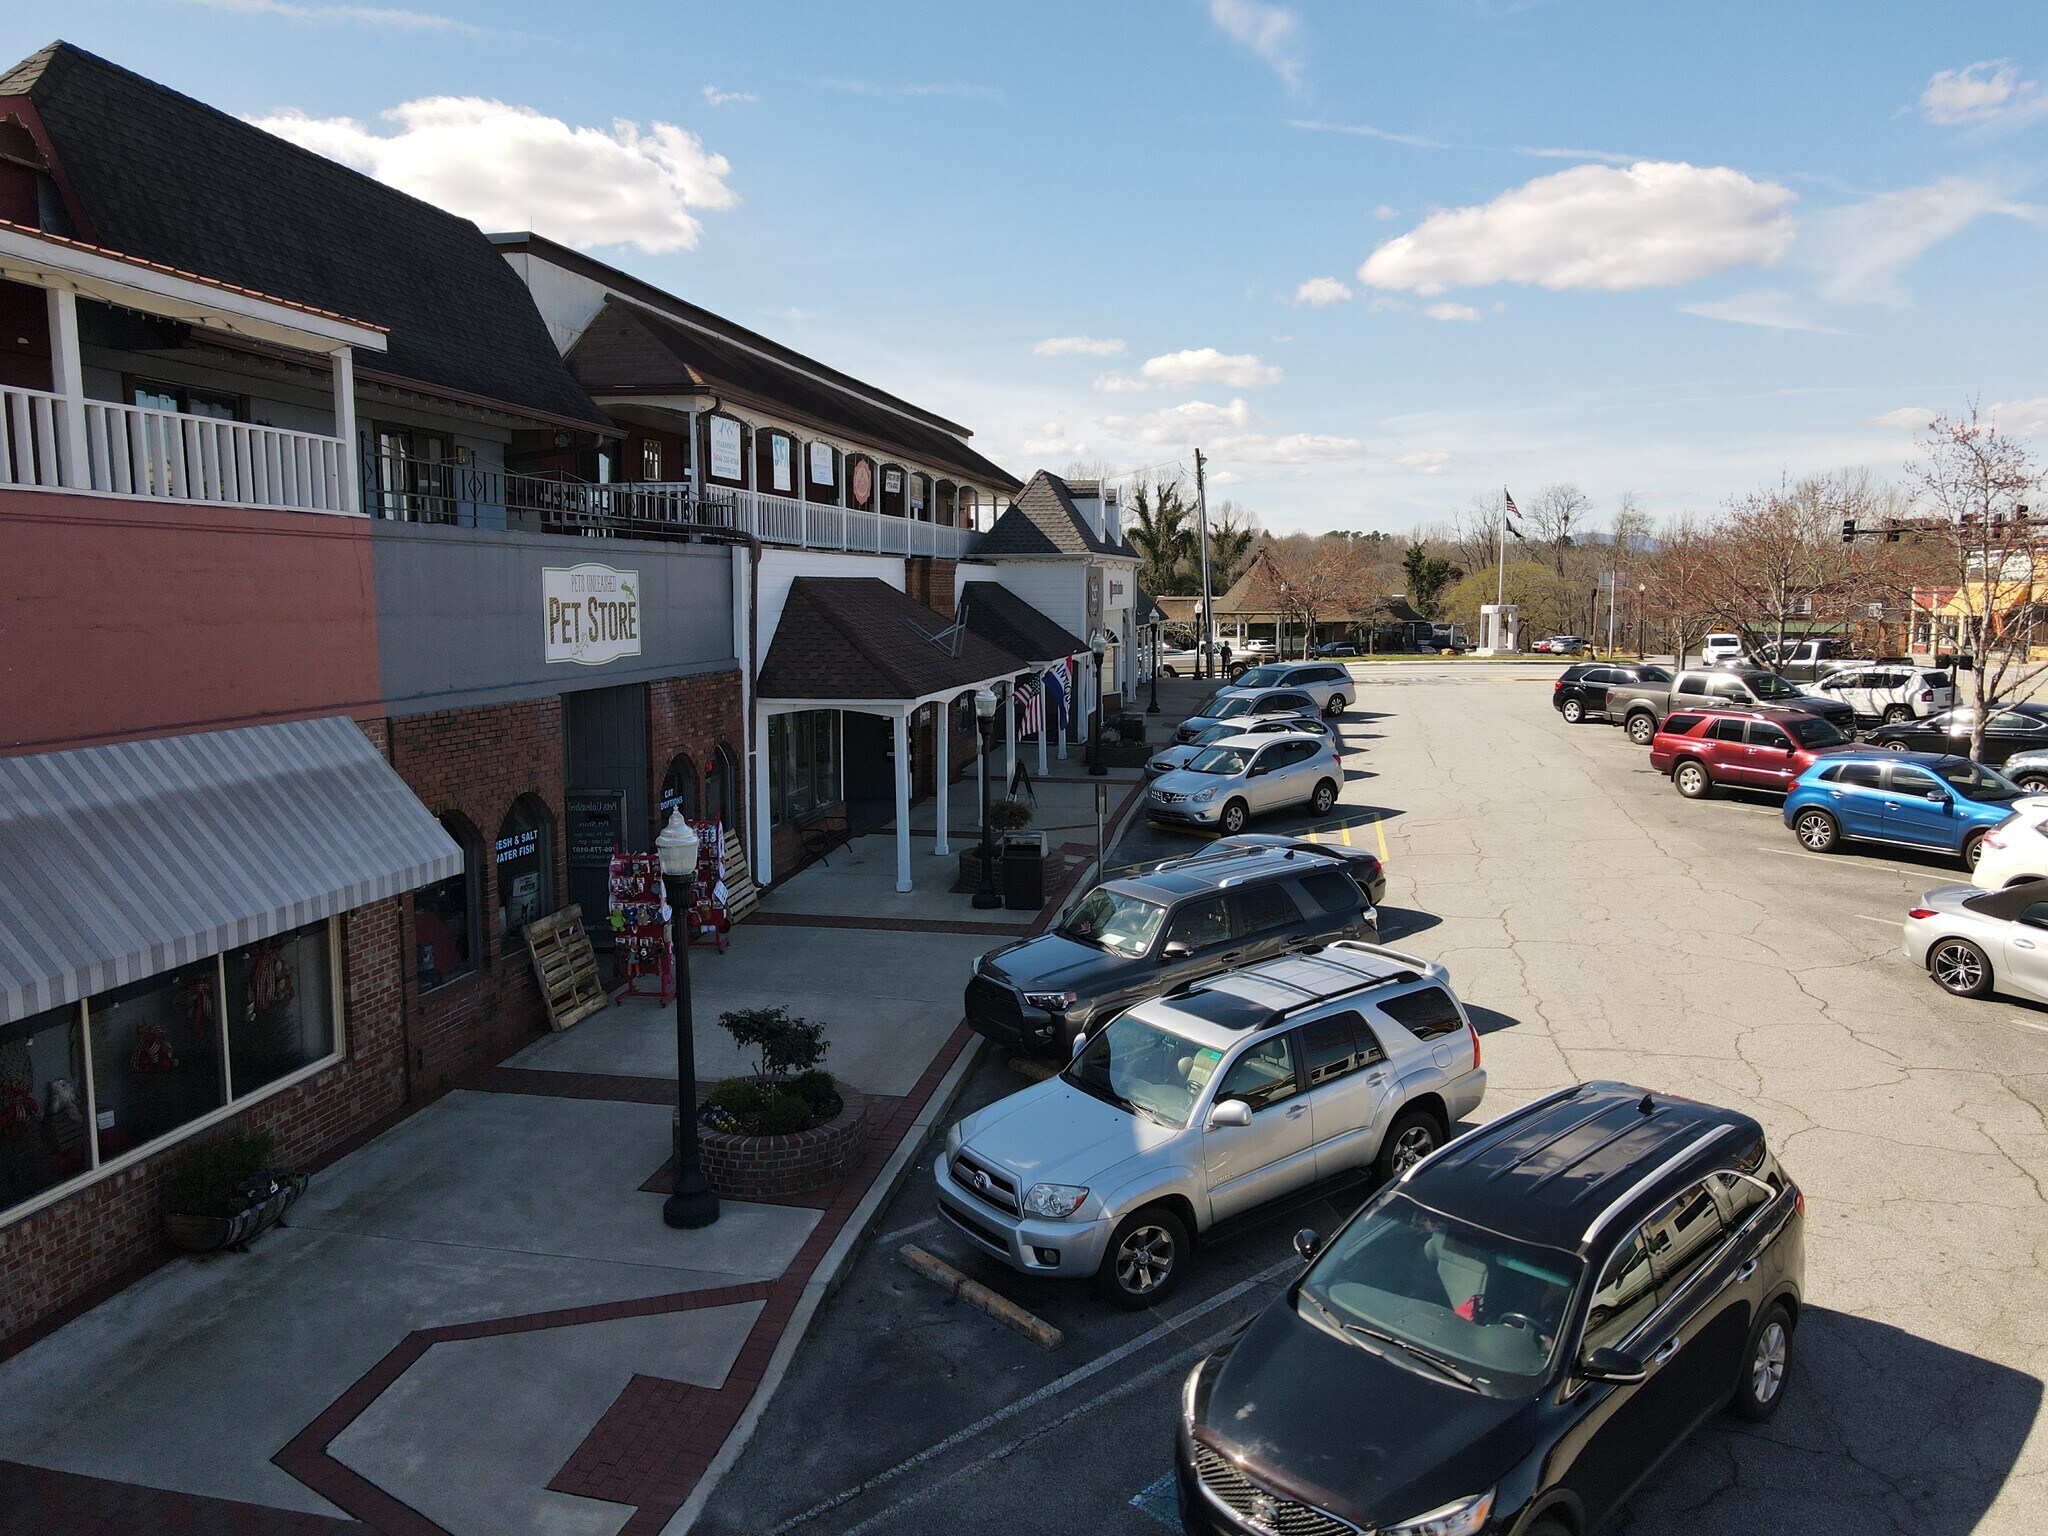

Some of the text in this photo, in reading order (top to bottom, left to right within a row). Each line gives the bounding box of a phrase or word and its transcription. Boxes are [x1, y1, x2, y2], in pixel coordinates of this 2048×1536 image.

[571, 574, 617, 592] PETS UNLEASHED
[549, 596, 637, 644] PET STORE
[664, 788, 674, 799] CAT
[660, 796, 684, 811] DOPTIONS
[495, 829, 539, 851] RESH & SALT
[519, 843, 535, 857] FISH
